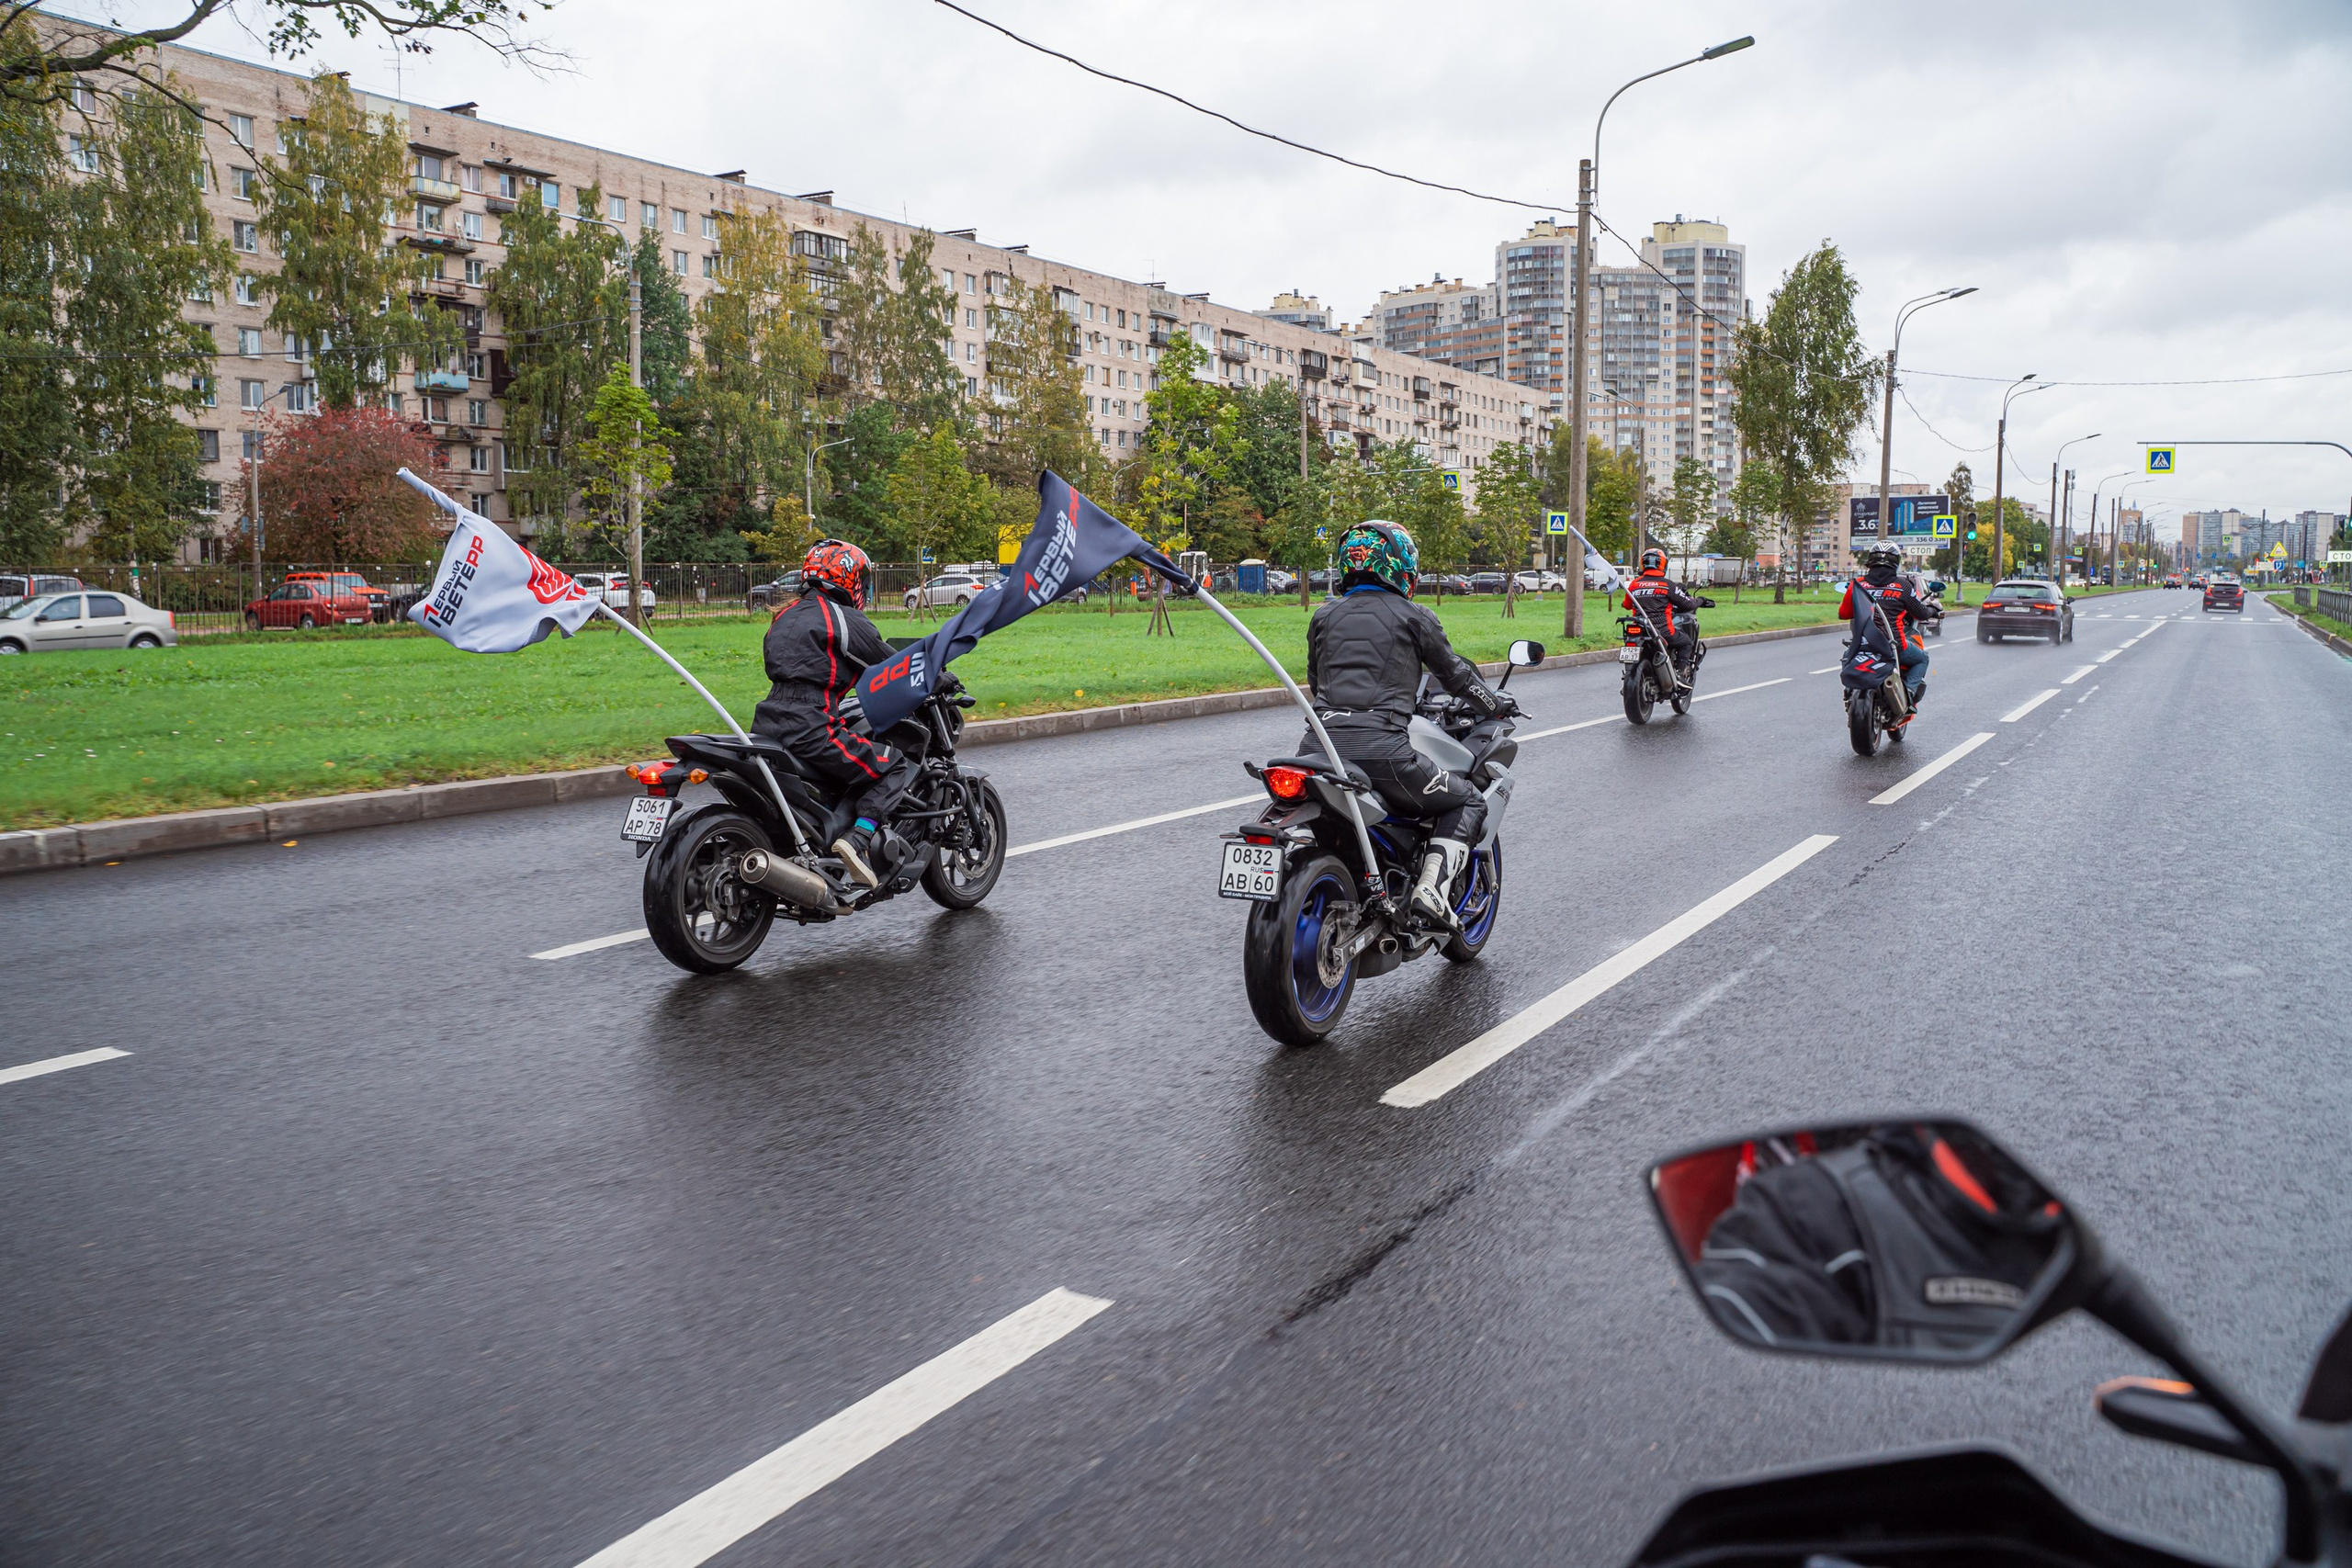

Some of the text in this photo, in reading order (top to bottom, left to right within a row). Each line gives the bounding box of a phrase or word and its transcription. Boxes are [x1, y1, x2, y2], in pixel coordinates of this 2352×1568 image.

[439, 535, 484, 626] ВЕТЕРР
[1867, 589, 1902, 599] TERR
[636, 799, 666, 814] 5061
[1233, 848, 1272, 865] 0832
